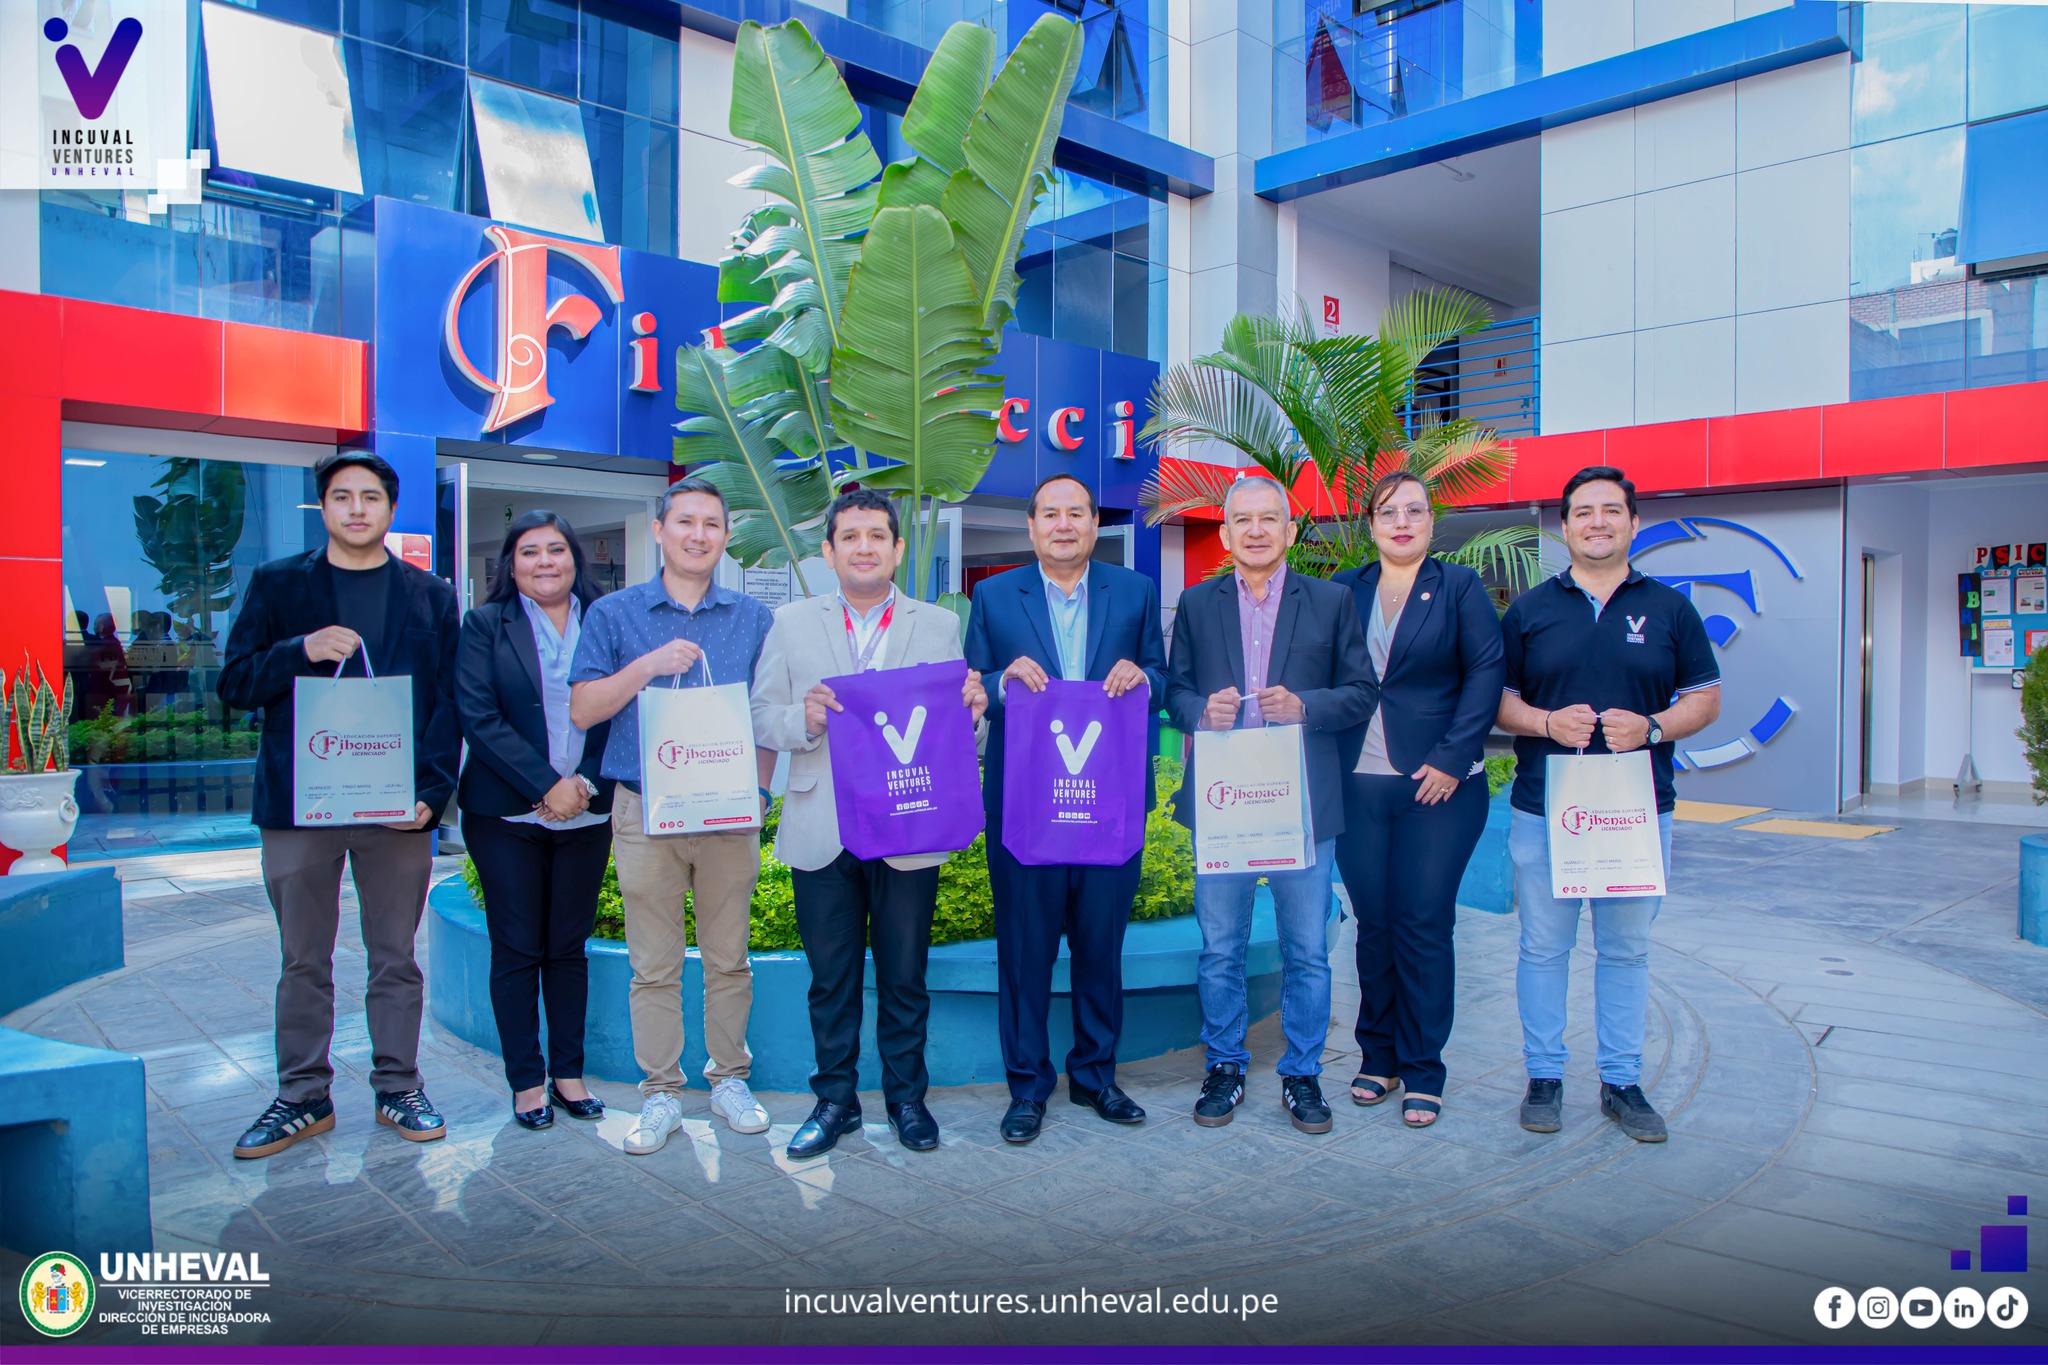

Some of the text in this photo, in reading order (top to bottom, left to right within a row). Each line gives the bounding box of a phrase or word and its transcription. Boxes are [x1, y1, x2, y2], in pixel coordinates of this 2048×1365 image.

[1327, 300, 1337, 322] 2
[1961, 575, 1980, 656] ABRIL
[322, 735, 402, 755] Fibonacci
[669, 744, 744, 765] Fibonacci
[886, 766, 930, 780] INCUVAL
[887, 775, 931, 791] VENTURES
[1053, 778, 1096, 788] INCUVAL
[1053, 788, 1096, 799] VENTURES
[1218, 785, 1290, 805] Fibonacci
[1574, 811, 1647, 831] Fibonacci
